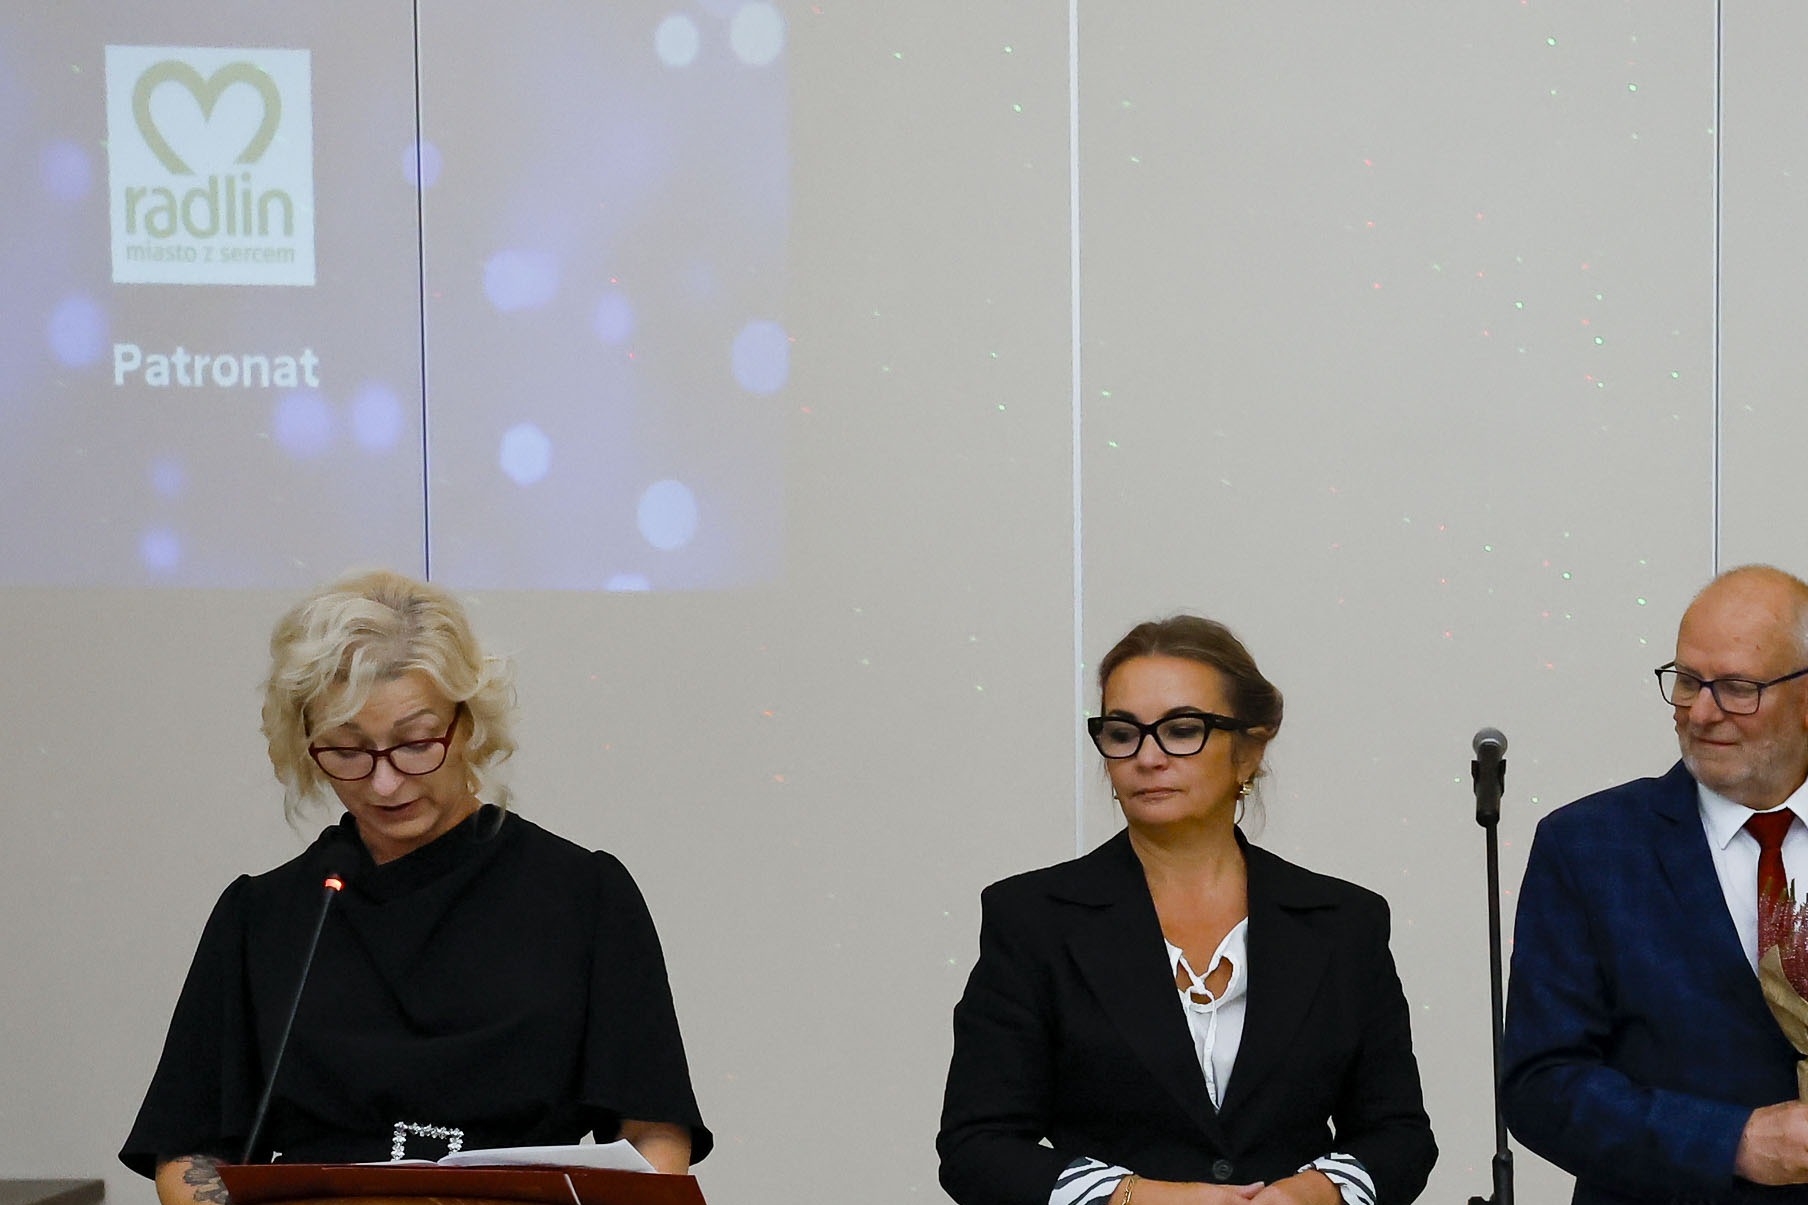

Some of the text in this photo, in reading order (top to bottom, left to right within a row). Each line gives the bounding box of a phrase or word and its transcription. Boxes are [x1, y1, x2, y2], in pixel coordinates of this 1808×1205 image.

[125, 171, 295, 239] radlin
[126, 244, 295, 264] miasto z sercem
[113, 343, 320, 387] Patronat
